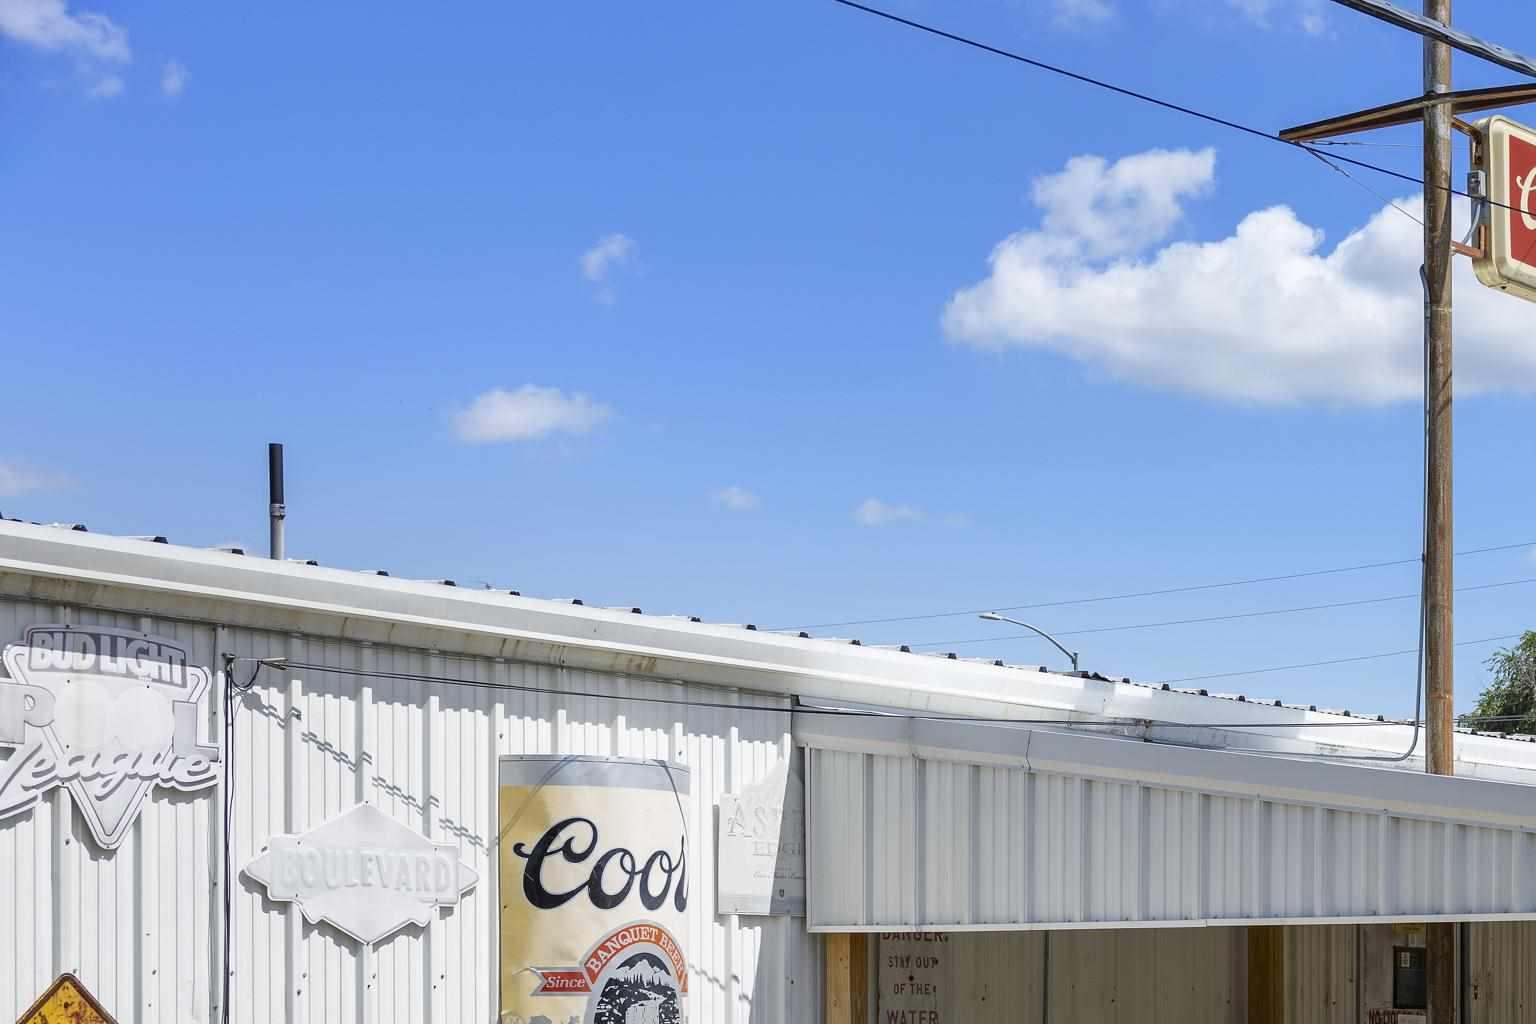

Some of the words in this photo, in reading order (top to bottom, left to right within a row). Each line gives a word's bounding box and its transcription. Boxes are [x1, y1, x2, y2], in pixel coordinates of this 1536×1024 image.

[31, 632, 96, 671] BUD
[101, 636, 186, 686] LIGHT
[280, 848, 450, 893] BOULEVARD
[587, 926, 659, 974] BANQUET
[660, 932, 685, 973] BEER
[888, 955, 911, 969] STAY
[915, 956, 938, 969] OUT
[545, 975, 585, 989] Since
[893, 983, 906, 995] OF
[910, 983, 931, 995] THE
